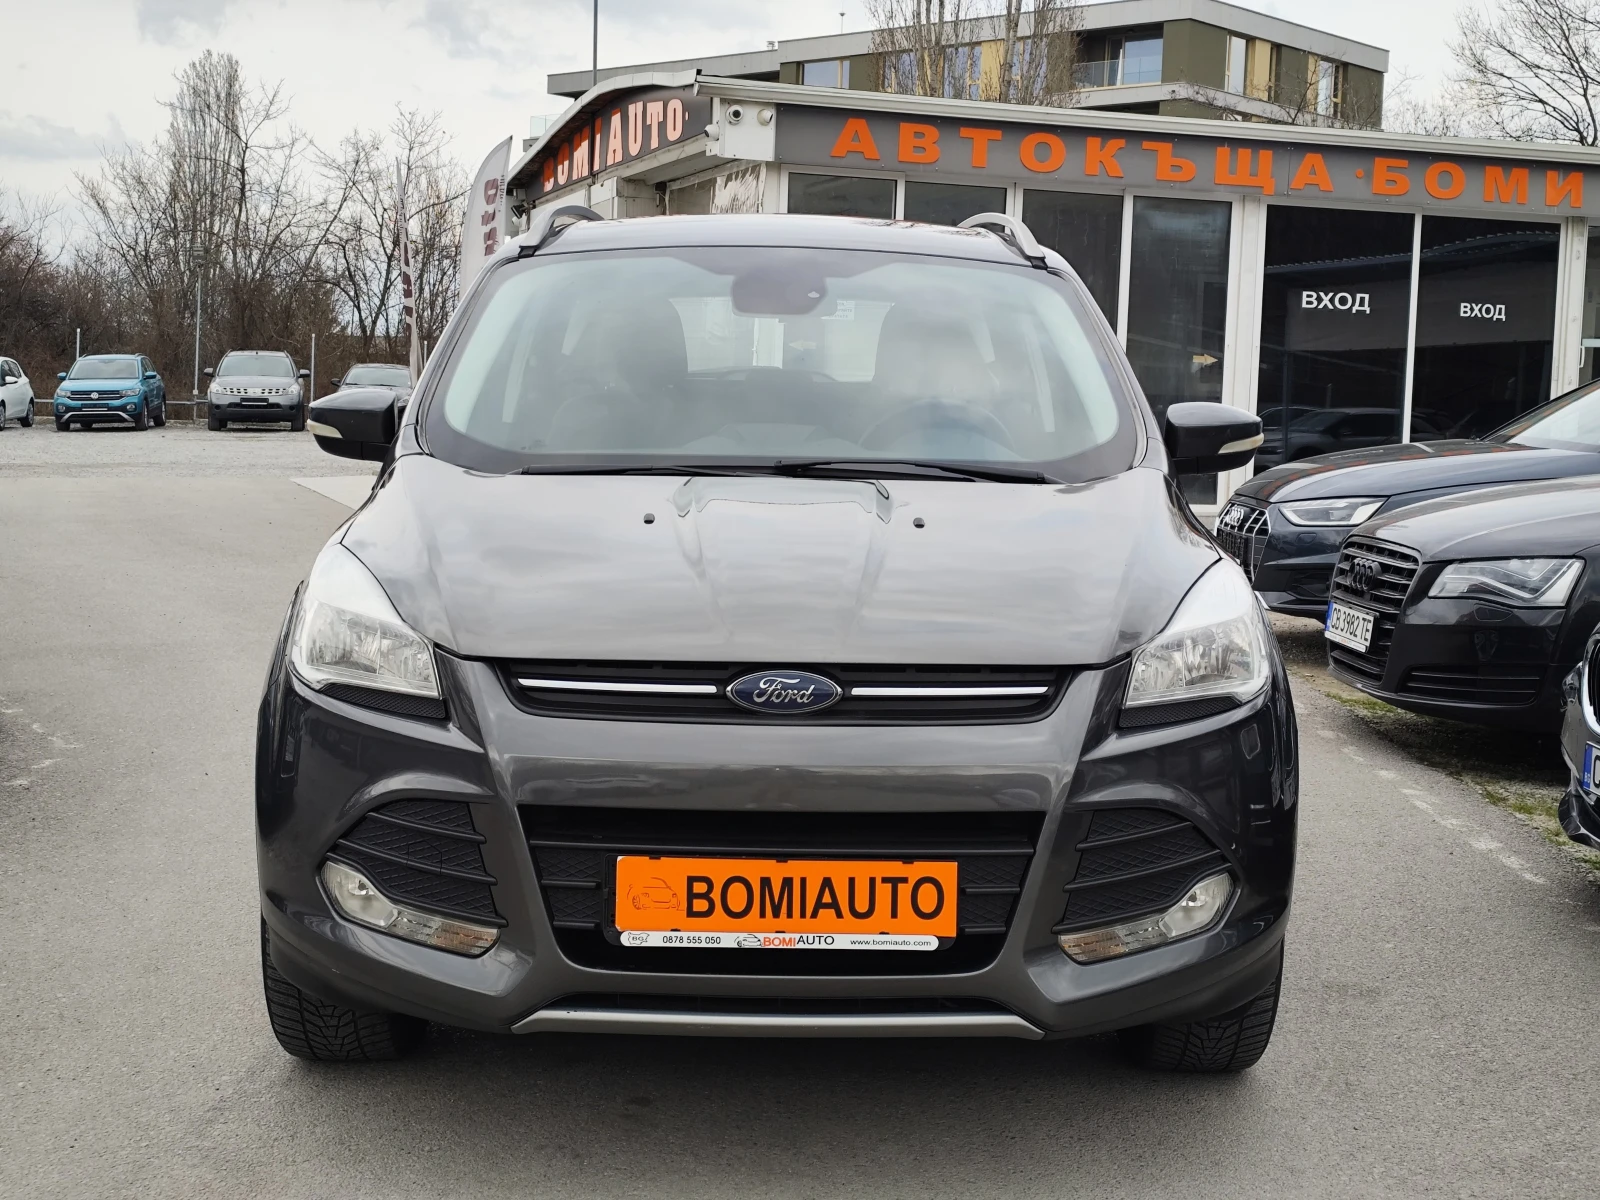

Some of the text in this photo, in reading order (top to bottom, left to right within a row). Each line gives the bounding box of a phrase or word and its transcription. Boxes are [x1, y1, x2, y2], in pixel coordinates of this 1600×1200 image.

[541, 99, 683, 193] BOMIAUTO
[1301, 291, 1371, 314] ВХОД
[1460, 302, 1506, 322] ВХОД
[1340, 610, 1360, 638] 3982
[753, 676, 816, 703] Ford
[686, 875, 945, 920] BOMIAUTO
[662, 935, 684, 944] 0878
[686, 935, 703, 944] 555
[704, 936, 722, 945] 050
[850, 938, 932, 947] www.bomiauto.com
